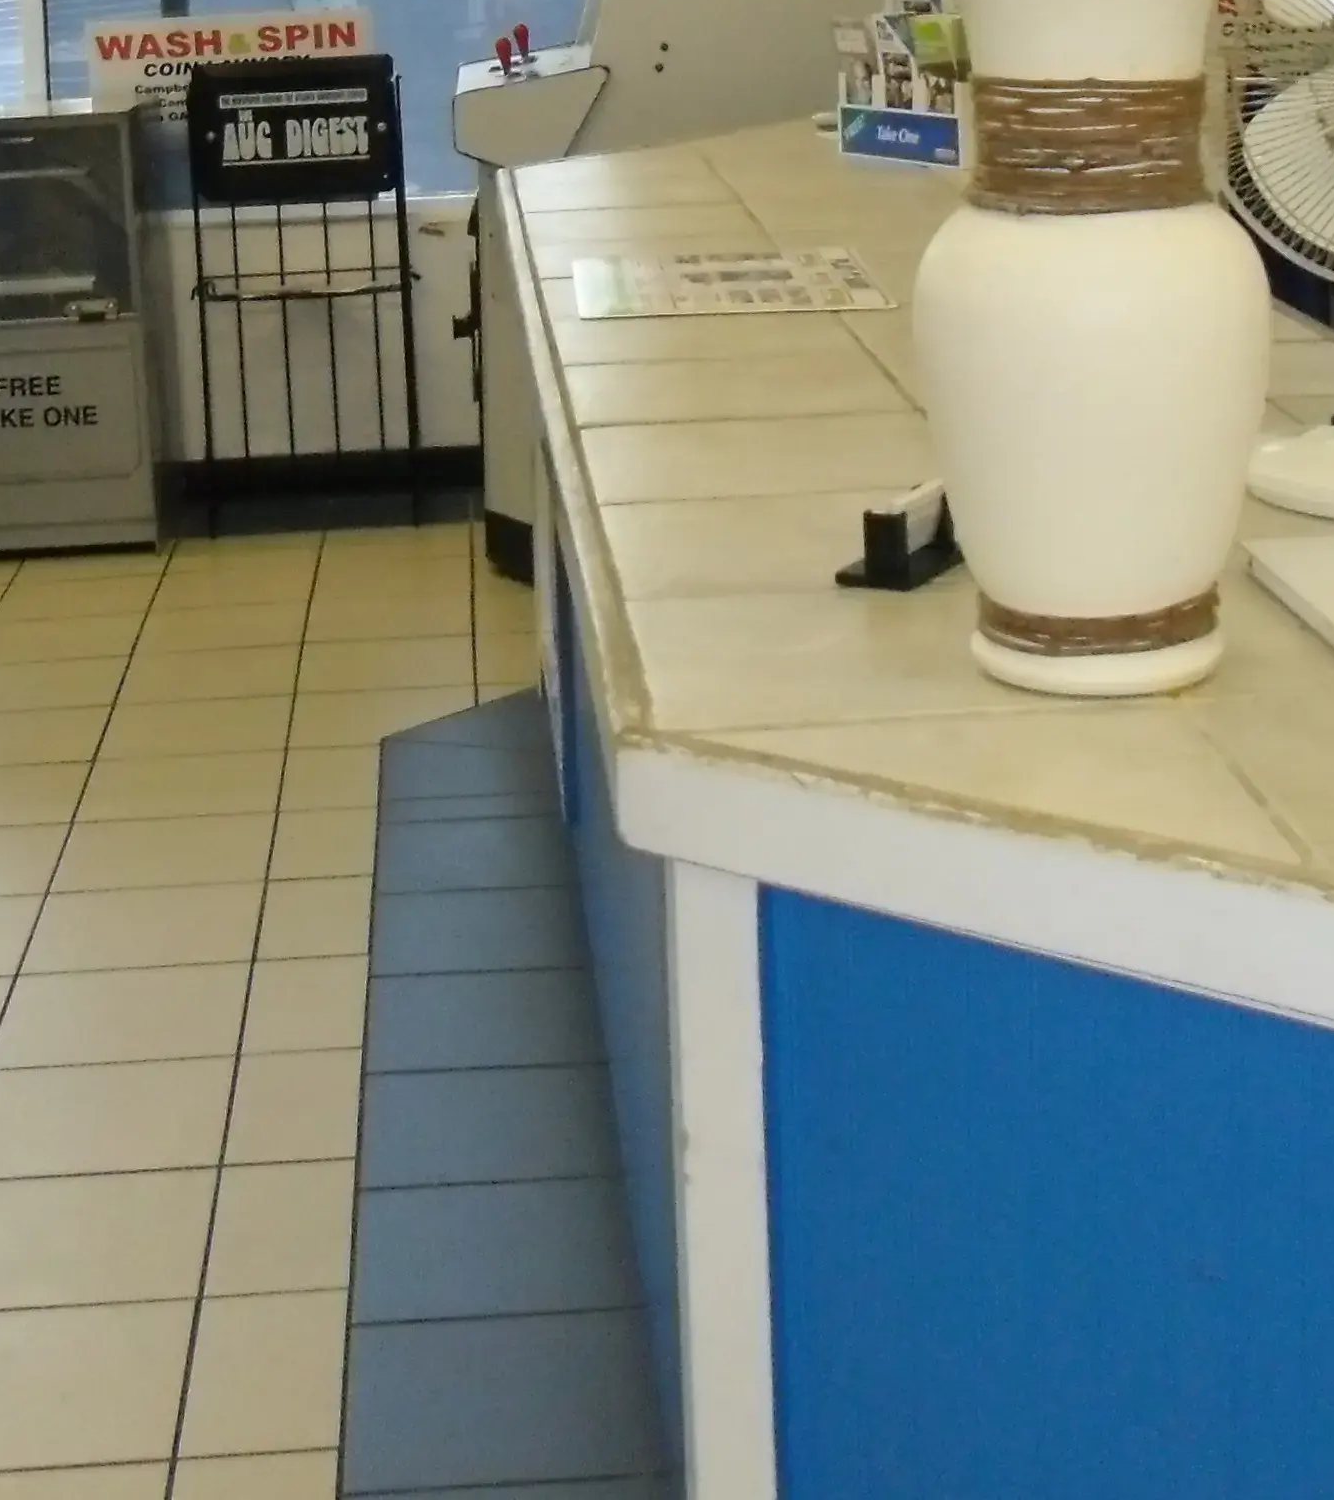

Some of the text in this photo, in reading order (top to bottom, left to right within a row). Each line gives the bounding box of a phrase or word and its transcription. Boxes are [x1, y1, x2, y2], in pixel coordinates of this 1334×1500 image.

[95, 29, 223, 60] WASH
[257, 21, 357, 52] SPIN
[222, 115, 370, 161] AUG DIGEST
[43, 405, 99, 428] ONE
